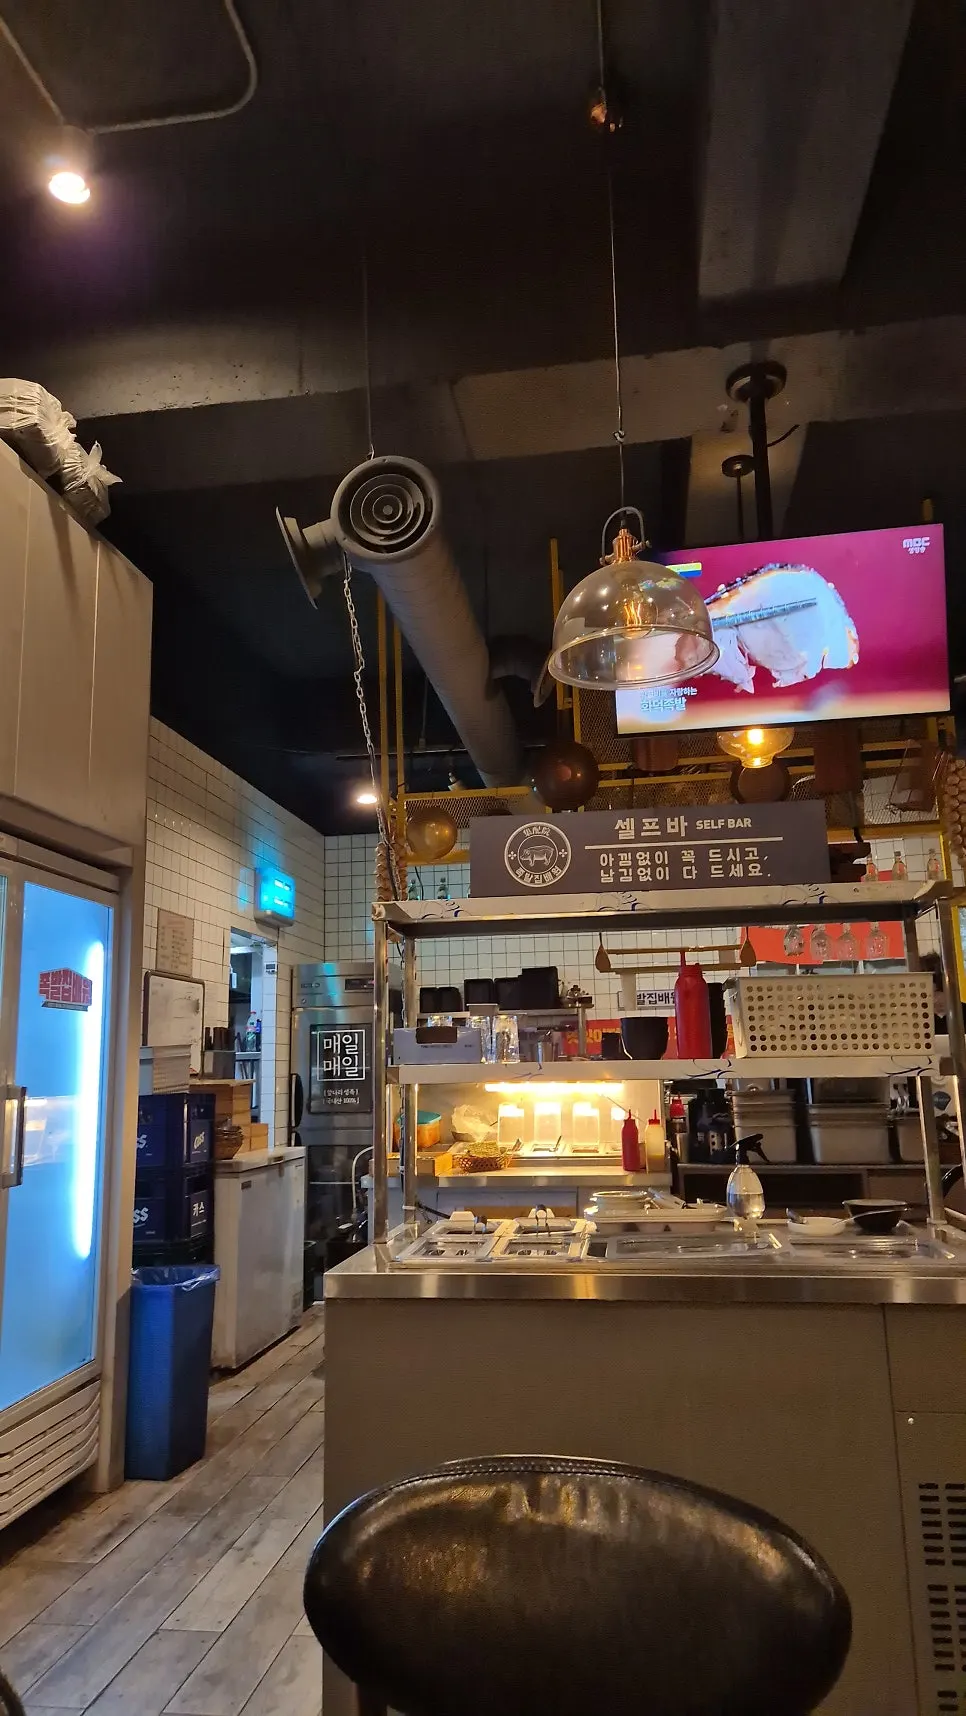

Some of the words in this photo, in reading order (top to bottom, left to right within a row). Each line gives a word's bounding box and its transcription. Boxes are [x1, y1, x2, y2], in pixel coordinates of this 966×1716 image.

[614, 815, 688, 840] 셀프바
[695, 819, 725, 830] SELF
[727, 818, 752, 829] BAR
[600, 850, 669, 867] 아낌없이
[681, 850, 696, 863] 꼭
[708, 847, 769, 862] 드시고,
[515, 865, 562, 884] 족발집배원
[600, 866, 670, 883] 남김없이
[682, 865, 698, 880] 다
[710, 863, 771, 879] 드세요.
[636, 991, 675, 1006] 발집배
[323, 1032, 359, 1055] 매일
[323, 1054, 359, 1077] 매일
[192, 1201, 205, 1216] 카스
